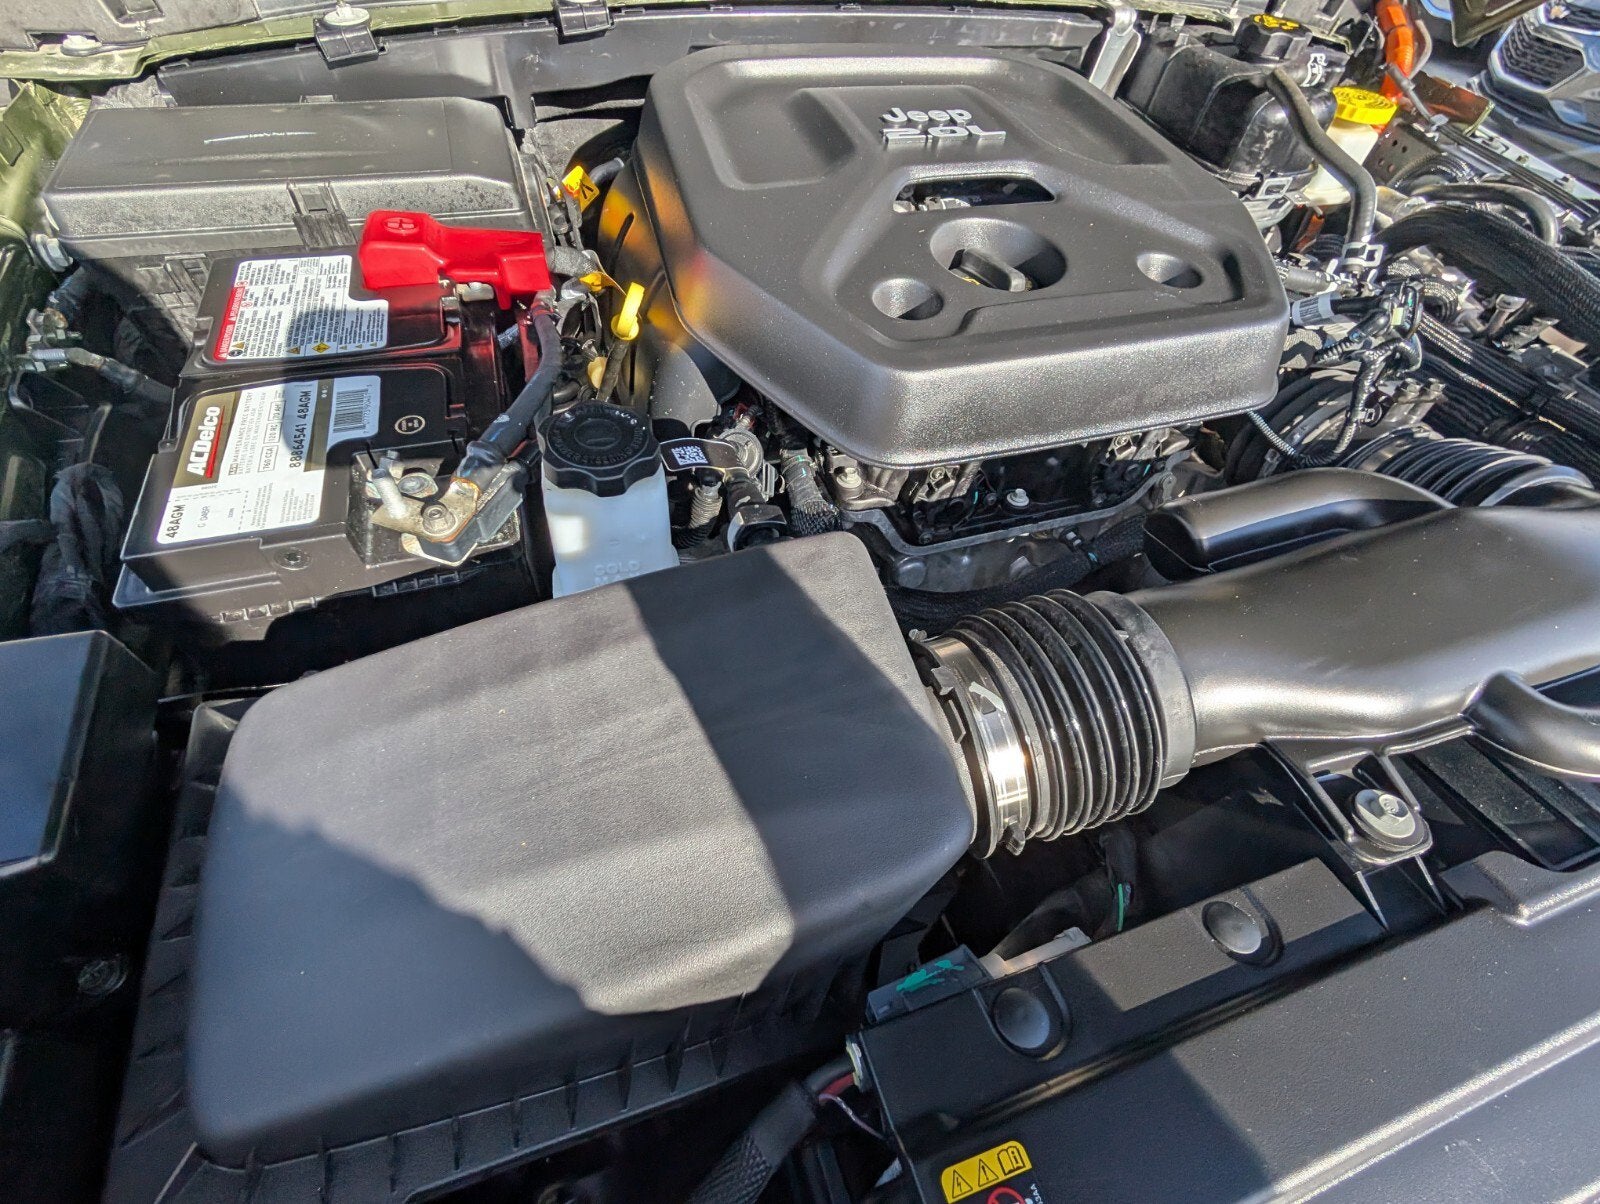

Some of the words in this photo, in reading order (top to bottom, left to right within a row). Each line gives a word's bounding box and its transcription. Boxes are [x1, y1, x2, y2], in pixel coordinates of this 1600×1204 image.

[879, 107, 972, 125] Jeep
[881, 125, 1006, 144] 2.0L
[297, 390, 312, 420] 48AGM
[187, 406, 221, 476] ACDelco
[268, 431, 276, 441] 120
[289, 423, 307, 468] 88864541
[265, 447, 273, 458] CCA
[165, 504, 186, 538] 48AGM
